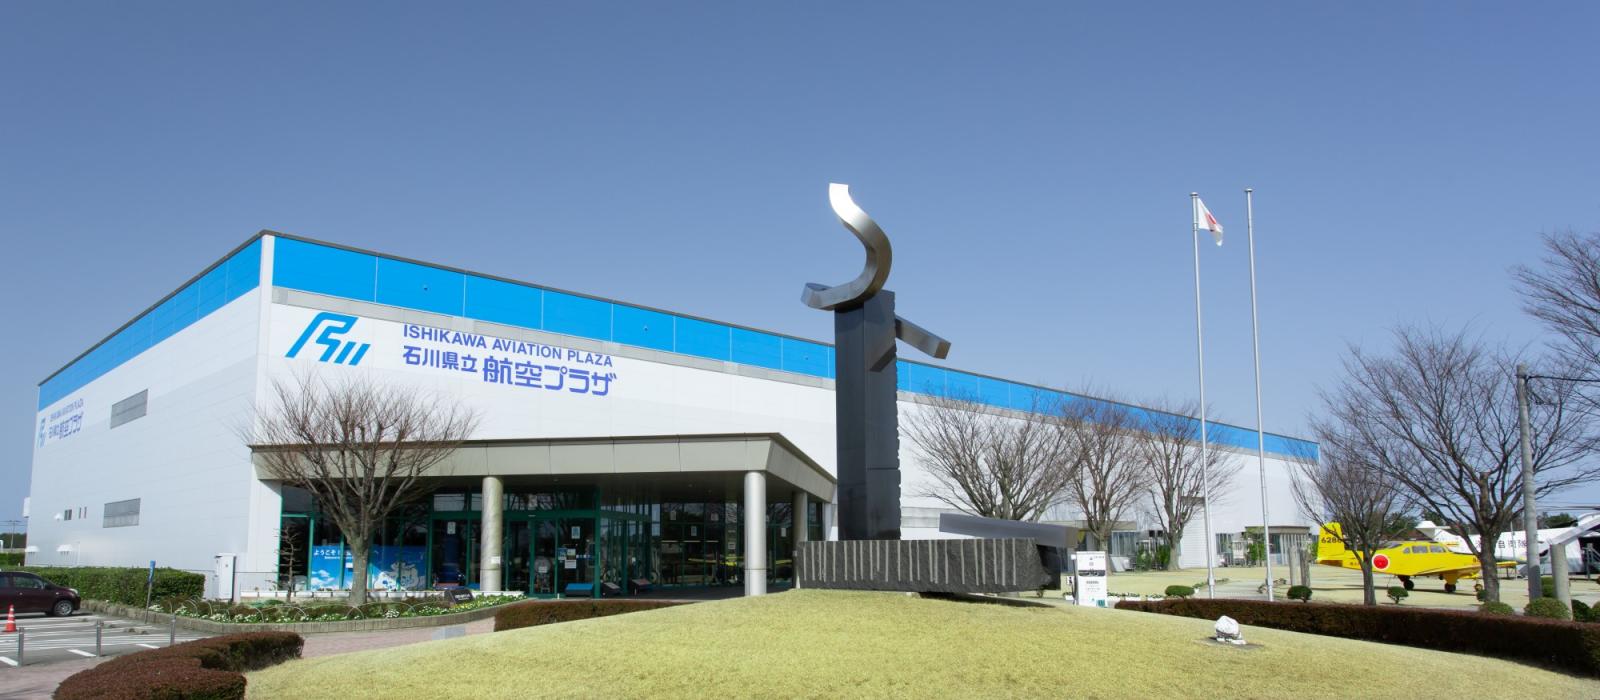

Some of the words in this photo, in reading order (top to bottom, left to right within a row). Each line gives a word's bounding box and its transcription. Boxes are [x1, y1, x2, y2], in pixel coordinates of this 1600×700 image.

[403, 324, 487, 349] ISHIKAWA
[492, 338, 562, 361] AVIATION
[567, 349, 613, 368] PLAZA
